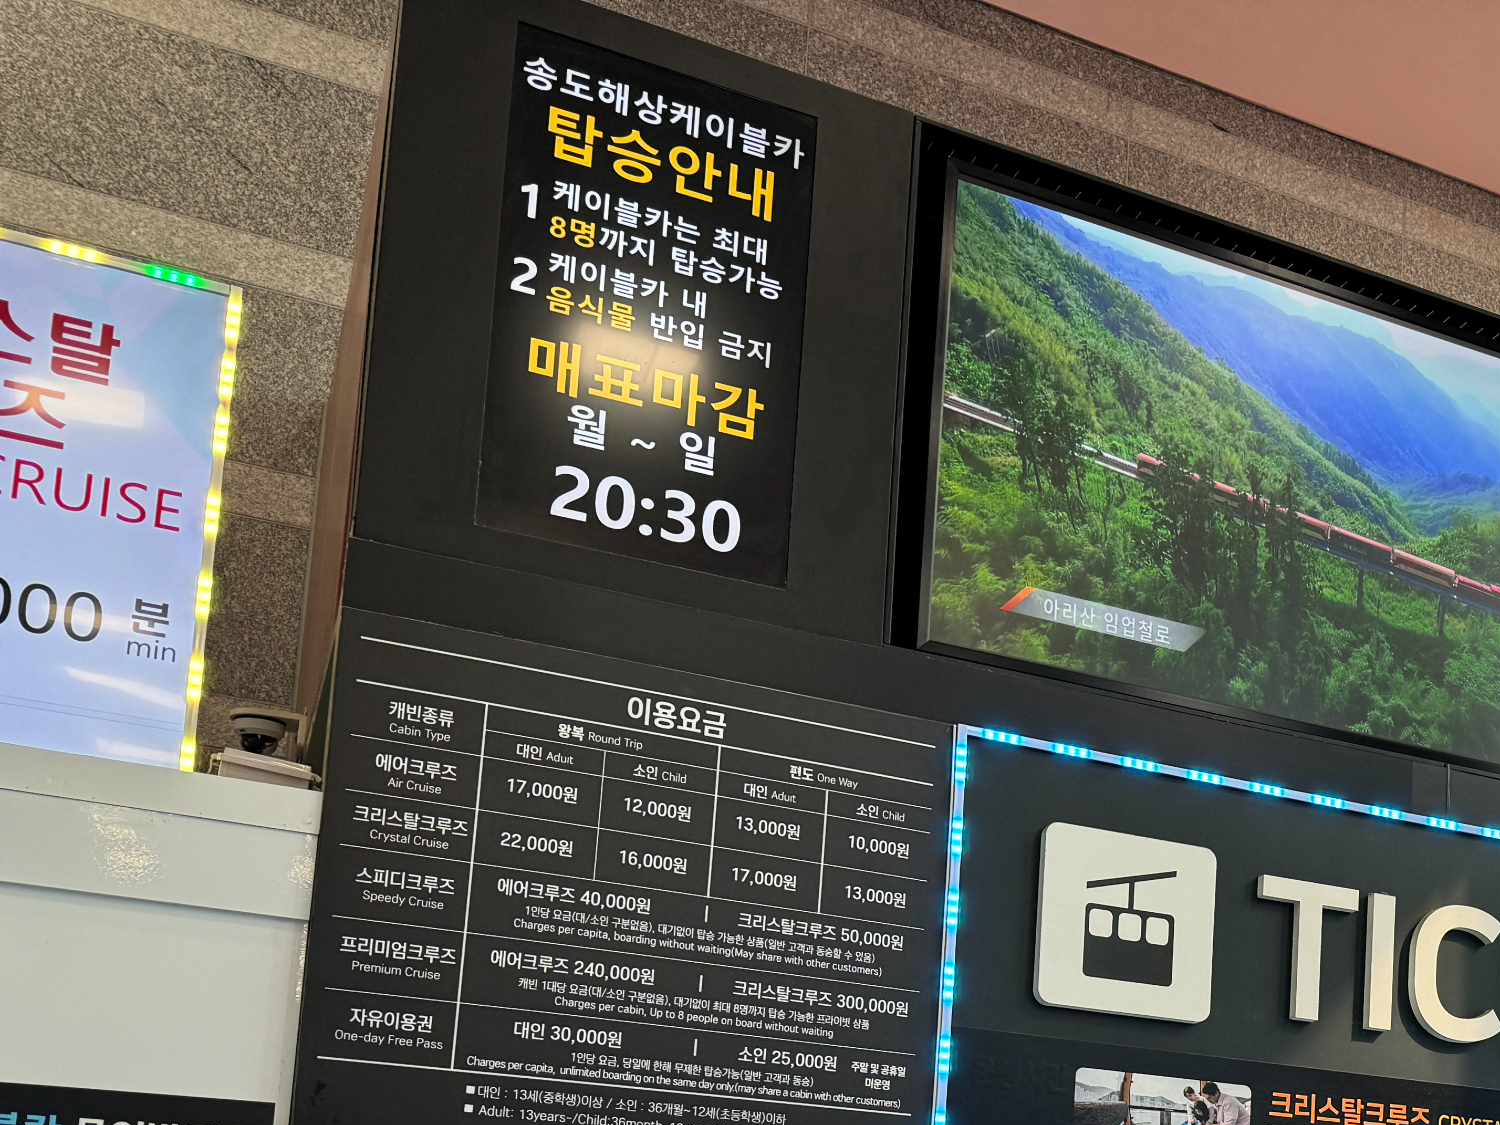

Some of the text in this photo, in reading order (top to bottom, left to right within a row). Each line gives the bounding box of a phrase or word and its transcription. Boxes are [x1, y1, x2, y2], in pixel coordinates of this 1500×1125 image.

[524, 54, 804, 169] 송도해상케이블카
[548, 102, 774, 224] 탑승안내
[522, 181, 767, 265] 1 케이블카는 최대
[550, 213, 782, 299] 8명까지 탑승가능
[511, 253, 706, 318] 2 케이블카 내
[546, 286, 771, 368] 음식물 반입 금지
[528, 337, 764, 440] 매표마감
[567, 405, 606, 450] 월
[680, 432, 716, 475] 일
[0, 455, 182, 531] RUISE
[550, 466, 740, 552] 20:30
[132, 599, 169, 637] 분
[1044, 599, 1170, 644] 아리산 임업철로
[127, 640, 175, 662] min
[389, 702, 454, 731] 캐빈종류
[628, 697, 726, 739] 이용요금
[390, 723, 450, 742] Cabin Type
[556, 723, 642, 751] 왕복 Round Trip
[376, 754, 457, 781] 에어크루즈
[790, 765, 858, 789] 편도 One Way
[388, 778, 441, 794] Air Cruise
[508, 779, 577, 804] 17,000원
[353, 806, 467, 839] 크리스탈크루즈
[624, 798, 691, 822] 12,000원
[370, 829, 448, 849] Crystal Cruise
[736, 816, 800, 840] 13,000원
[501, 832, 573, 857] 22,000원
[849, 836, 909, 859] 10,000원
[620, 850, 687, 874] 16,000원
[356, 868, 454, 898] 스피디크루즈
[732, 868, 796, 891] 17,000원
[498, 879, 650, 914] 에어크루즈 40,000원
[845, 886, 906, 908] 13,000원
[736, 913, 903, 951] 크리스탈크루즈 50,000원
[340, 936, 456, 967] 프리미엄크루즈
[733, 981, 908, 1017] 크리스탈크루즈 300,000원
[350, 1008, 432, 1033] 자유이용권
[335, 1030, 443, 1049] One-day Free Pass
